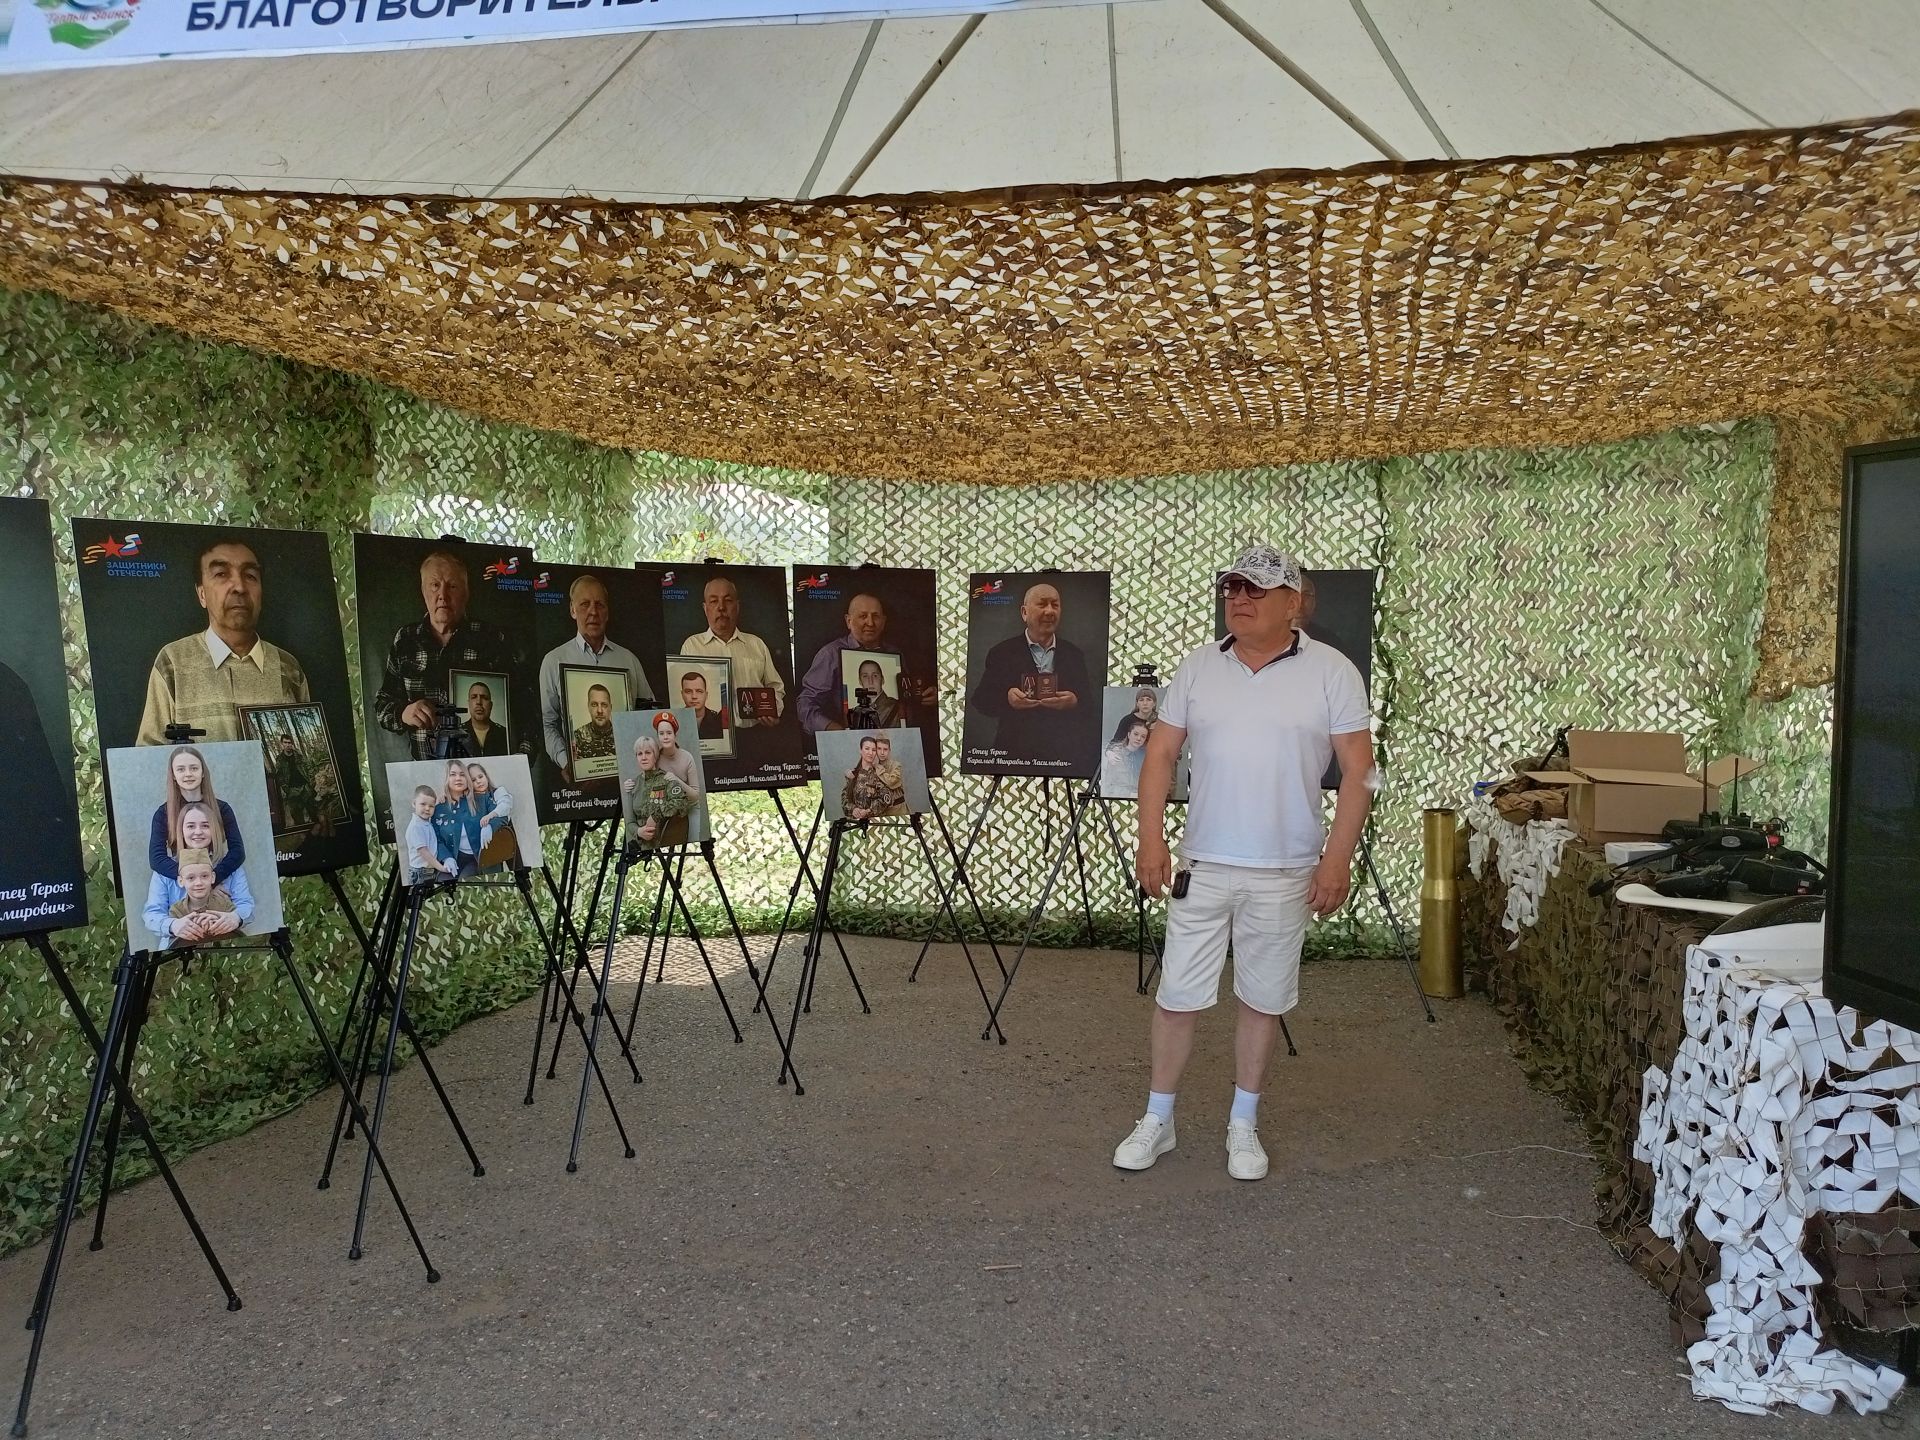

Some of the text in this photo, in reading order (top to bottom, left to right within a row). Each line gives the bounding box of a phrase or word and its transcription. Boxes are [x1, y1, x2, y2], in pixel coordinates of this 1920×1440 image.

[106, 561, 167, 571] ЗАЩИТНИКИ
[107, 569, 161, 577] ОТЕЧЕСТВА
[496, 577, 533, 586] ЗАЩИТНИКИ
[759, 762, 802, 772] «Отец Героя:
[748, 774, 778, 783] Николай
[777, 772, 803, 781] Ильич»
[561, 788, 582, 799] Героя:
[571, 799, 594, 810] Сергей
[593, 797, 620, 808] Федоро
[31, 882, 74, 899] Героя:
